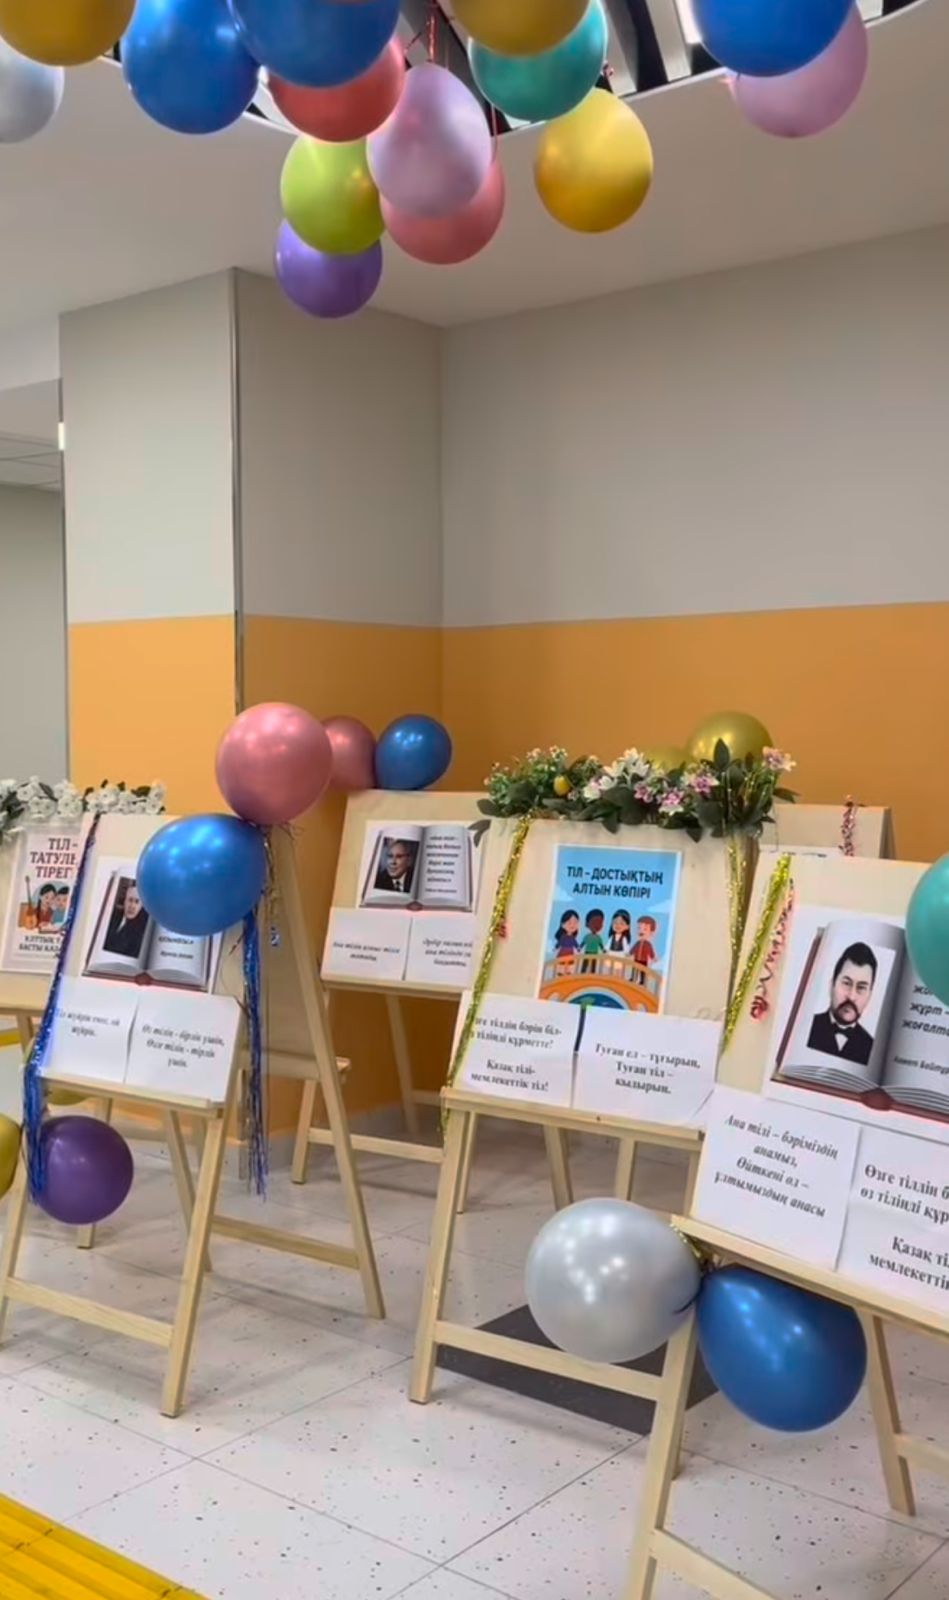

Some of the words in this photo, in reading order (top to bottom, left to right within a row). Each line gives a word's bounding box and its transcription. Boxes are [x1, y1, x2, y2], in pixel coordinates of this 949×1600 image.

[49, 837, 71, 850] ТІЛ
[566, 866, 583, 878] ТІЛ
[591, 867, 663, 885] ДОСТЫҚТЫҢ
[572, 883, 611, 896] АЛТЫН
[613, 885, 651, 899] КӨПІРІ
[616, 1060, 647, 1075] Туған
[649, 1066, 665, 1078] тіл
[470, 1073, 529, 1089] мемлекеттік
[724, 1114, 746, 1130] Ана
[747, 1121, 773, 1138] тілі
[752, 1144, 798, 1168] анамыз,
[736, 1155, 786, 1182] Өйткені
[785, 1175, 800, 1188] ол
[864, 1163, 896, 1185] Өзге
[860, 1187, 875, 1200] өз
[789, 1197, 826, 1218] анасы
